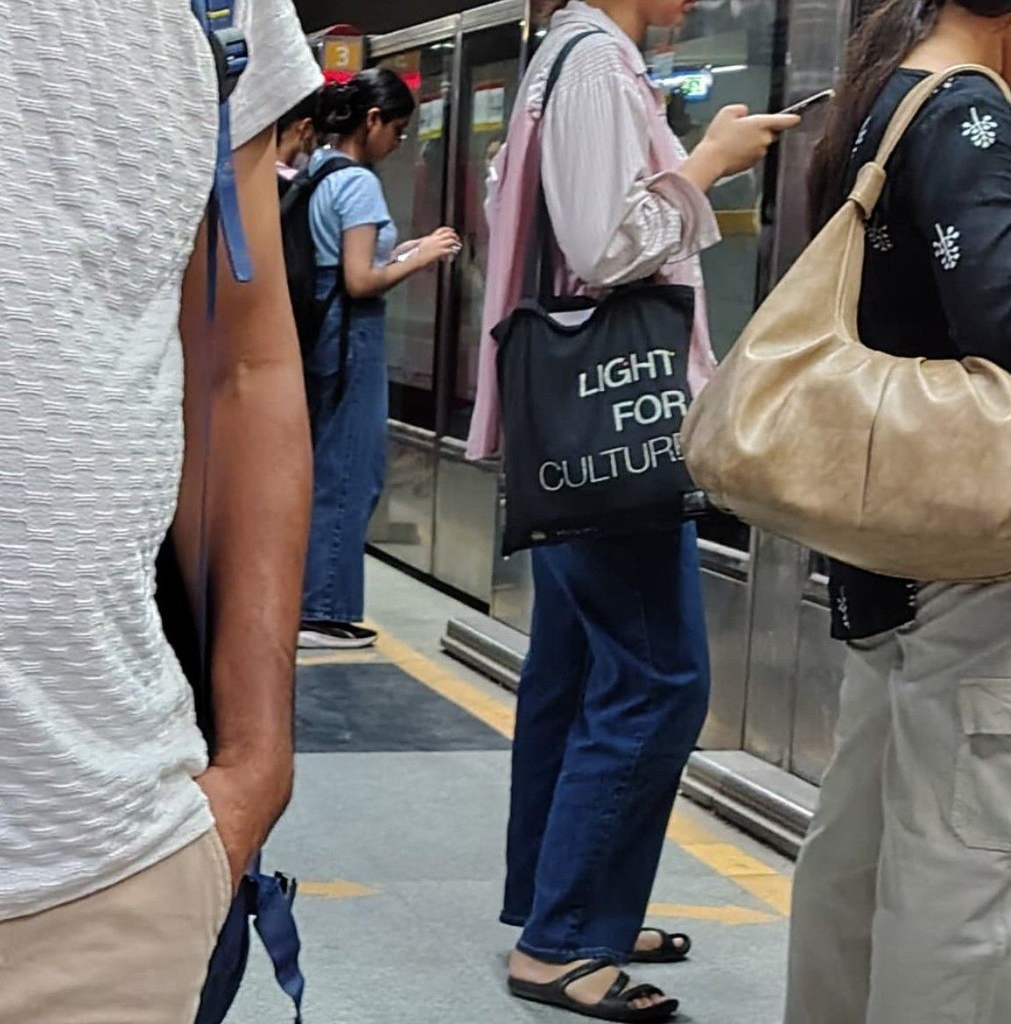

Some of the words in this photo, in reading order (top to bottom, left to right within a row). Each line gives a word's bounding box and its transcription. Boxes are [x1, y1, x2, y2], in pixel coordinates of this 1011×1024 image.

[335, 45, 350, 67] 3
[578, 349, 676, 398] LIGHT
[612, 390, 688, 432] FOR
